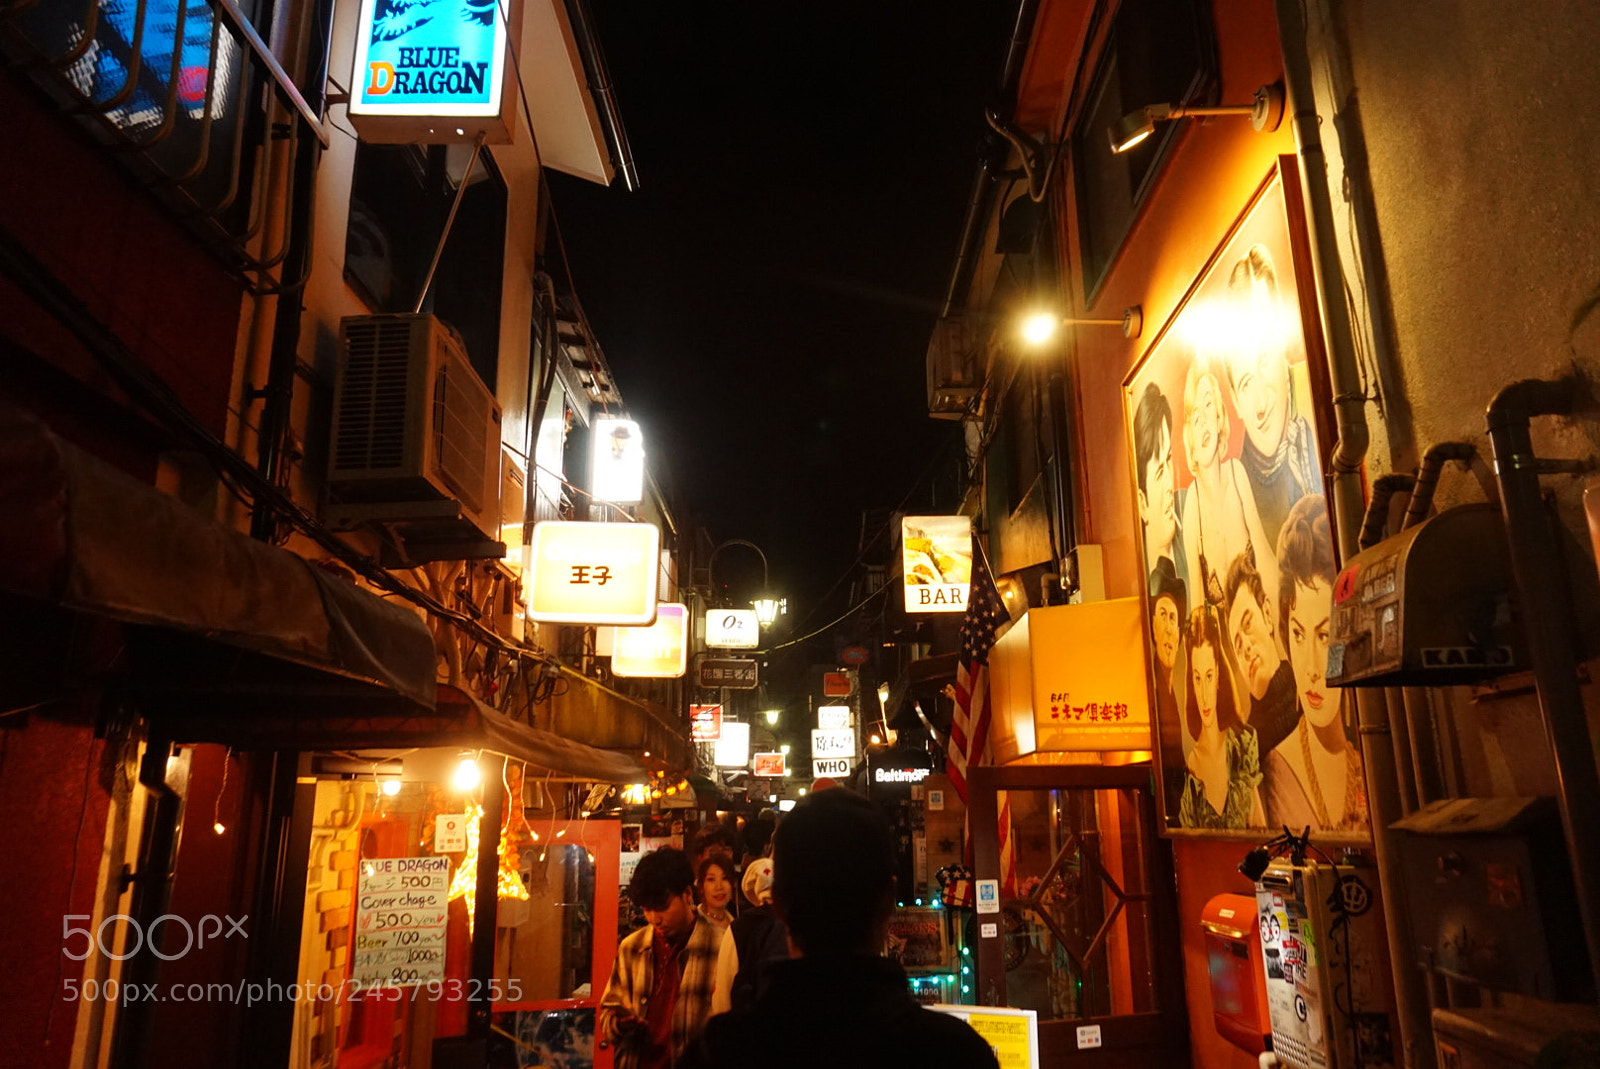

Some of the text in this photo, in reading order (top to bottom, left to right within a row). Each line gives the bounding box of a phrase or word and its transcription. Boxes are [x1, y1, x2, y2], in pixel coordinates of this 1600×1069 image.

[397, 47, 460, 68] BLUE
[367, 62, 489, 95] DRAGON
[570, 566, 612, 585] 王子
[919, 588, 963, 604] BAR
[1051, 693, 1070, 703] BAR
[817, 761, 848, 773] WHO
[397, 859, 449, 872] DRAGON
[361, 897, 396, 909] Cover
[376, 912, 412, 928] 500
[357, 935, 387, 949] Beer
